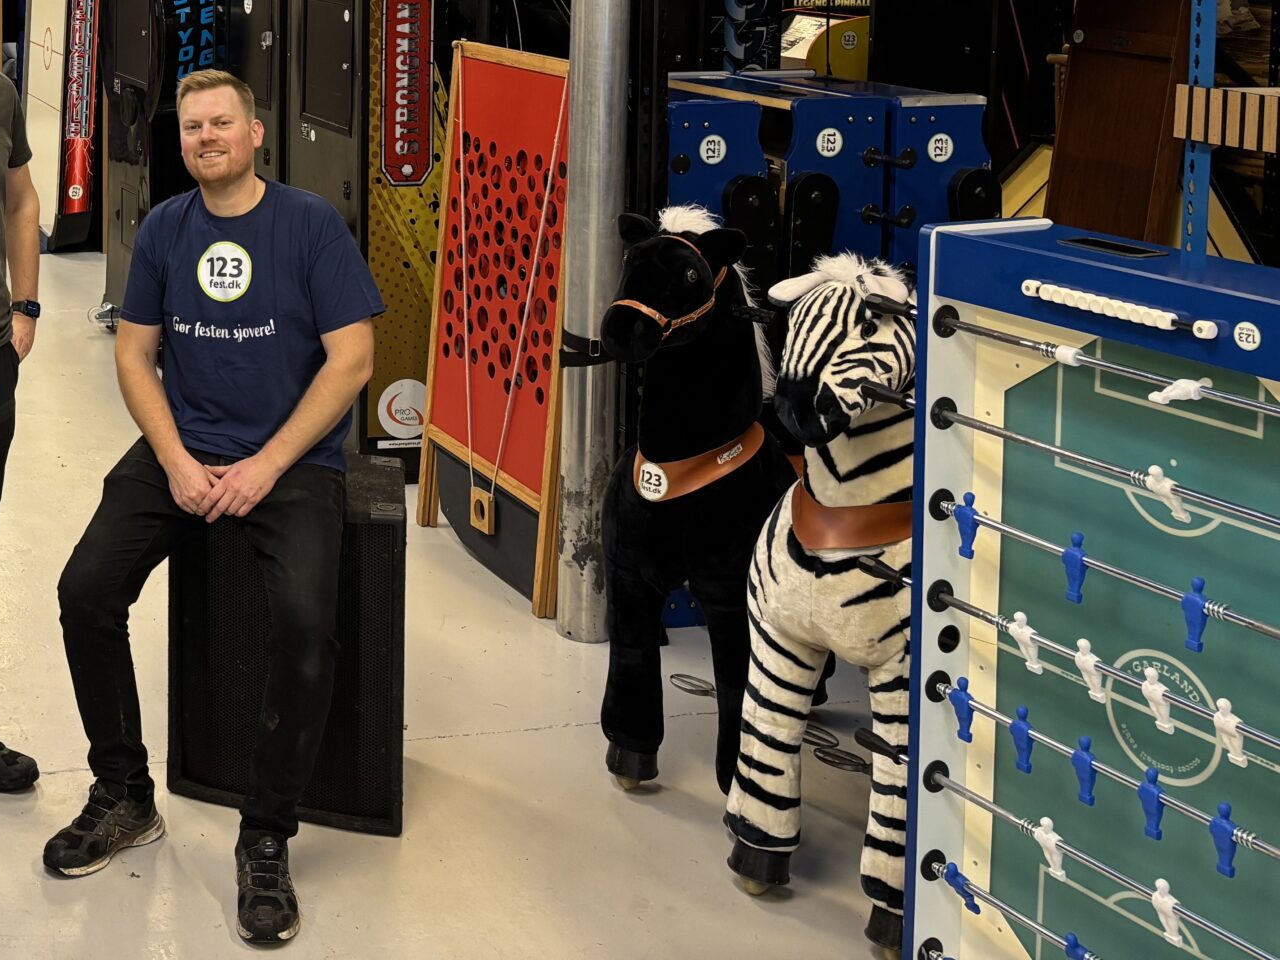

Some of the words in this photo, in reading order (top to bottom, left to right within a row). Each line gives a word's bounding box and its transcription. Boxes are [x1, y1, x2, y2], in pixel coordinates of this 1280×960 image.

[177, 28, 194, 80] YOU
[395, 2, 420, 156] STRONGMAN
[706, 140, 716, 160] 123
[826, 132, 836, 152] 123
[934, 138, 943, 158] 123
[72, 185, 80, 198] 123
[207, 256, 243, 278] 123
[209, 279, 241, 289] fest.dk
[173, 316, 191, 334] Gør
[195, 322, 230, 338] festen
[233, 319, 276, 342] sjovere!
[1238, 332, 1257, 344] 123
[394, 408, 411, 416] PRO
[641, 469, 662, 488] 123
[1132, 660, 1200, 703] GARLAND
